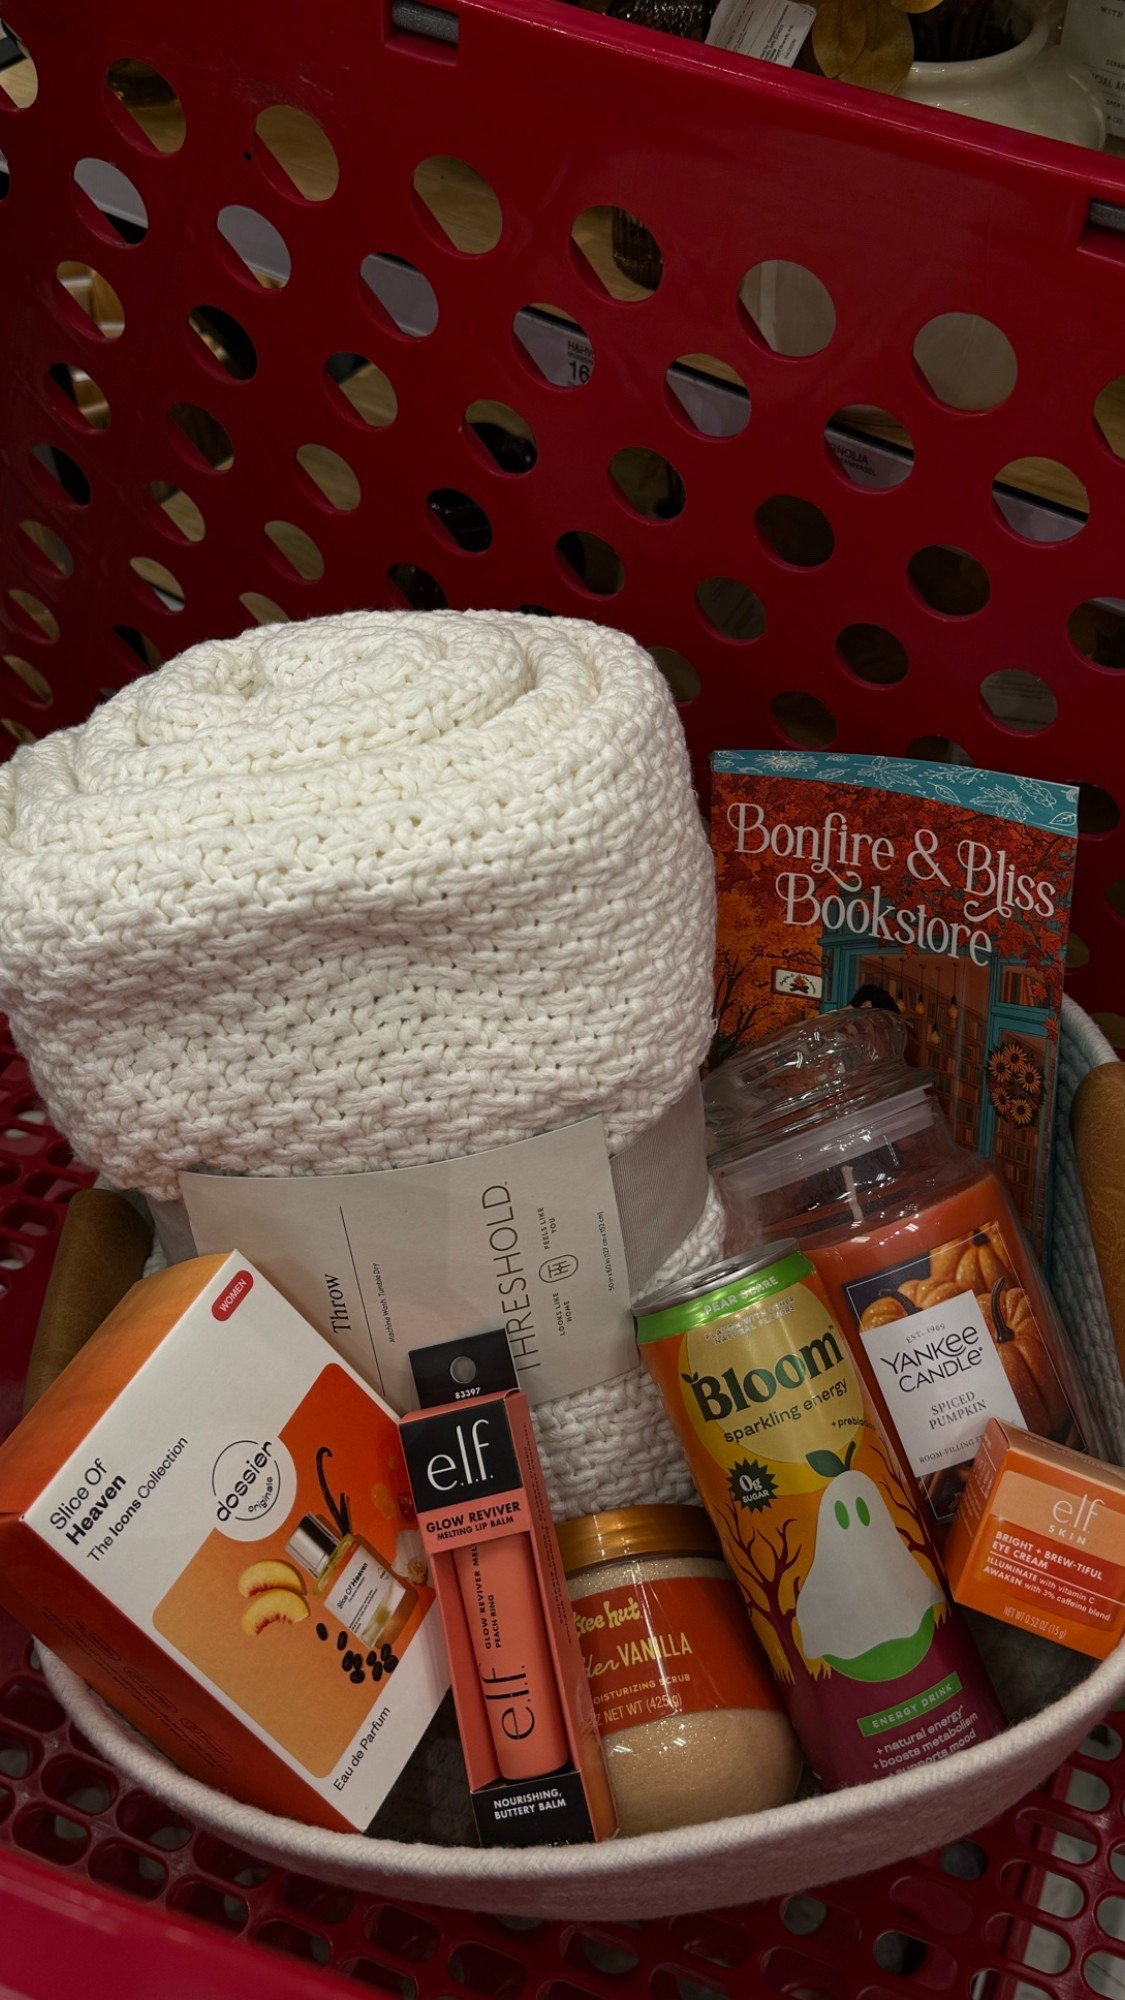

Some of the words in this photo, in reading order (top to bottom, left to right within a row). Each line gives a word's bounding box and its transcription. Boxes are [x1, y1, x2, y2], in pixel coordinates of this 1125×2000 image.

[727, 802, 894, 892] Bonfire
[907, 829, 951, 887] &
[957, 840, 1056, 922] Bliss
[775, 872, 992, 966] Bookstore
[537, 1208, 546, 1225] LIKE
[549, 1217, 557, 1234] YOU
[541, 1227, 550, 1249] FEELS
[219, 1278, 247, 1312] WOMEN
[325, 1274, 351, 1334] Throw
[552, 1293, 561, 1310] LIKE
[564, 1300, 572, 1322] HOME
[704, 1295, 738, 1316] PEAR
[739, 1275, 779, 1300] SCARE
[385, 1316, 395, 1343] Machine
[556, 1311, 565, 1335] LOOKS
[455, 1387, 481, 1400] 83397
[691, 1332, 844, 1423] Bloom
[724, 1405, 802, 1443] sparkling
[803, 1378, 848, 1411] energy
[929, 1399, 987, 1430] PUMPKIN
[931, 1391, 975, 1415] SPICED
[50, 1487, 89, 1530] Slice
[84, 1458, 107, 1486] Of
[217, 1441, 272, 1521] dossier
[248, 1476, 273, 1513] originals
[739, 1474, 763, 1492] 0g
[742, 1489, 770, 1503] SUGAR
[65, 1475, 127, 1546] Heaven
[86, 1535, 114, 1561] The
[108, 1499, 142, 1536] Icons
[137, 1437, 188, 1499] Collection
[426, 1514, 465, 1533] GLOW
[468, 1501, 522, 1524] REVIVER
[437, 1526, 472, 1541] MELTING
[475, 1523, 488, 1532] LIP
[490, 1516, 514, 1528] BALM
[1048, 1524, 1086, 1546] SKIN
[992, 1540, 1011, 1555] EYE
[1013, 1549, 1049, 1570] CREAM
[995, 1531, 1034, 1552] BRIGHT
[1043, 1550, 1103, 1580] BREW-TIFUL
[474, 1571, 485, 1614] REVIVER
[983, 1566, 1022, 1586] AWAKEN
[1024, 1581, 1042, 1594] with
[1056, 1595, 1087, 1612] caffeine
[1088, 1605, 1111, 1622] blend
[987, 1556, 1038, 1581] ILLUMINATE
[1039, 1577, 1057, 1590] with
[1058, 1584, 1087, 1602] vitamin
[1088, 1597, 1096, 1605] C
[488, 1594, 496, 1617] RING
[603, 1597, 641, 1628] hut
[481, 1617, 492, 1649] GLOW
[492, 1619, 501, 1648] PEACH
[617, 1632, 693, 1667] VANILLA
[593, 1680, 656, 1705] OISTURIZING
[659, 1673, 691, 1686] SCRUB
[604, 1705, 624, 1724] NET
[626, 1699, 643, 1716] WT
[871, 1704, 917, 1729] ENERGY
[921, 1683, 953, 1707] DRINK
[922, 1712, 979, 1752] metabolism
[949, 1727, 977, 1753] mood
[333, 1766, 354, 1791] Eau
[351, 1750, 364, 1767] de
[359, 1707, 391, 1751] Parfum
[493, 1787, 562, 1809] NOURISHING,
[494, 1804, 536, 1820] BUTTERY
[538, 1797, 567, 1811] BALM
